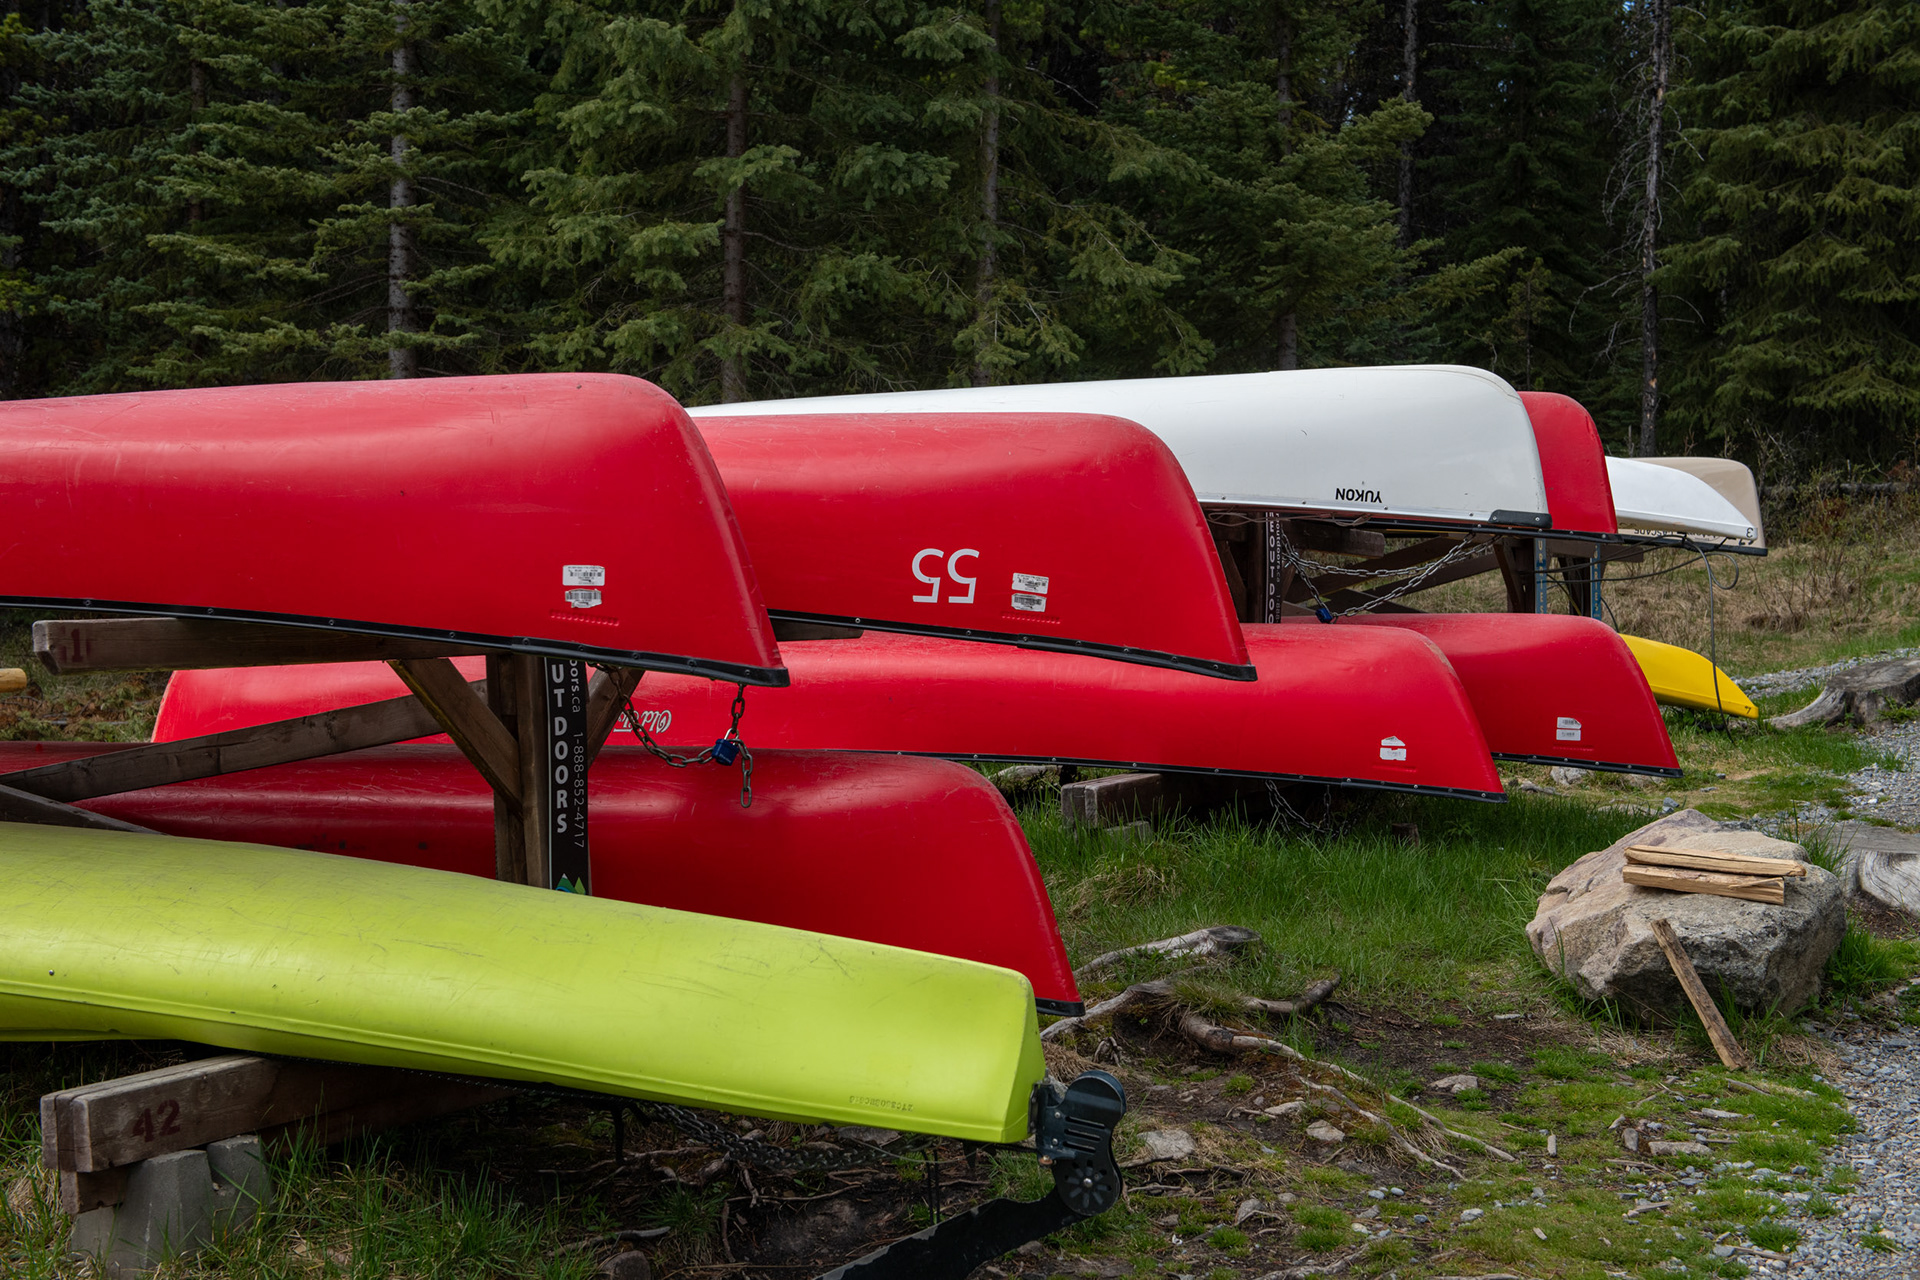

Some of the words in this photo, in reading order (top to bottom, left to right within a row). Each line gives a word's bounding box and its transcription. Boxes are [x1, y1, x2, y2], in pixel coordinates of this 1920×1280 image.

[1335, 488, 1382, 503] YUKON
[1746, 527, 1754, 539] 3
[912, 548, 980, 604] 55
[641, 709, 673, 734] Old
[573, 732, 585, 848] 1-888-852-4717
[132, 1099, 181, 1143] 42
